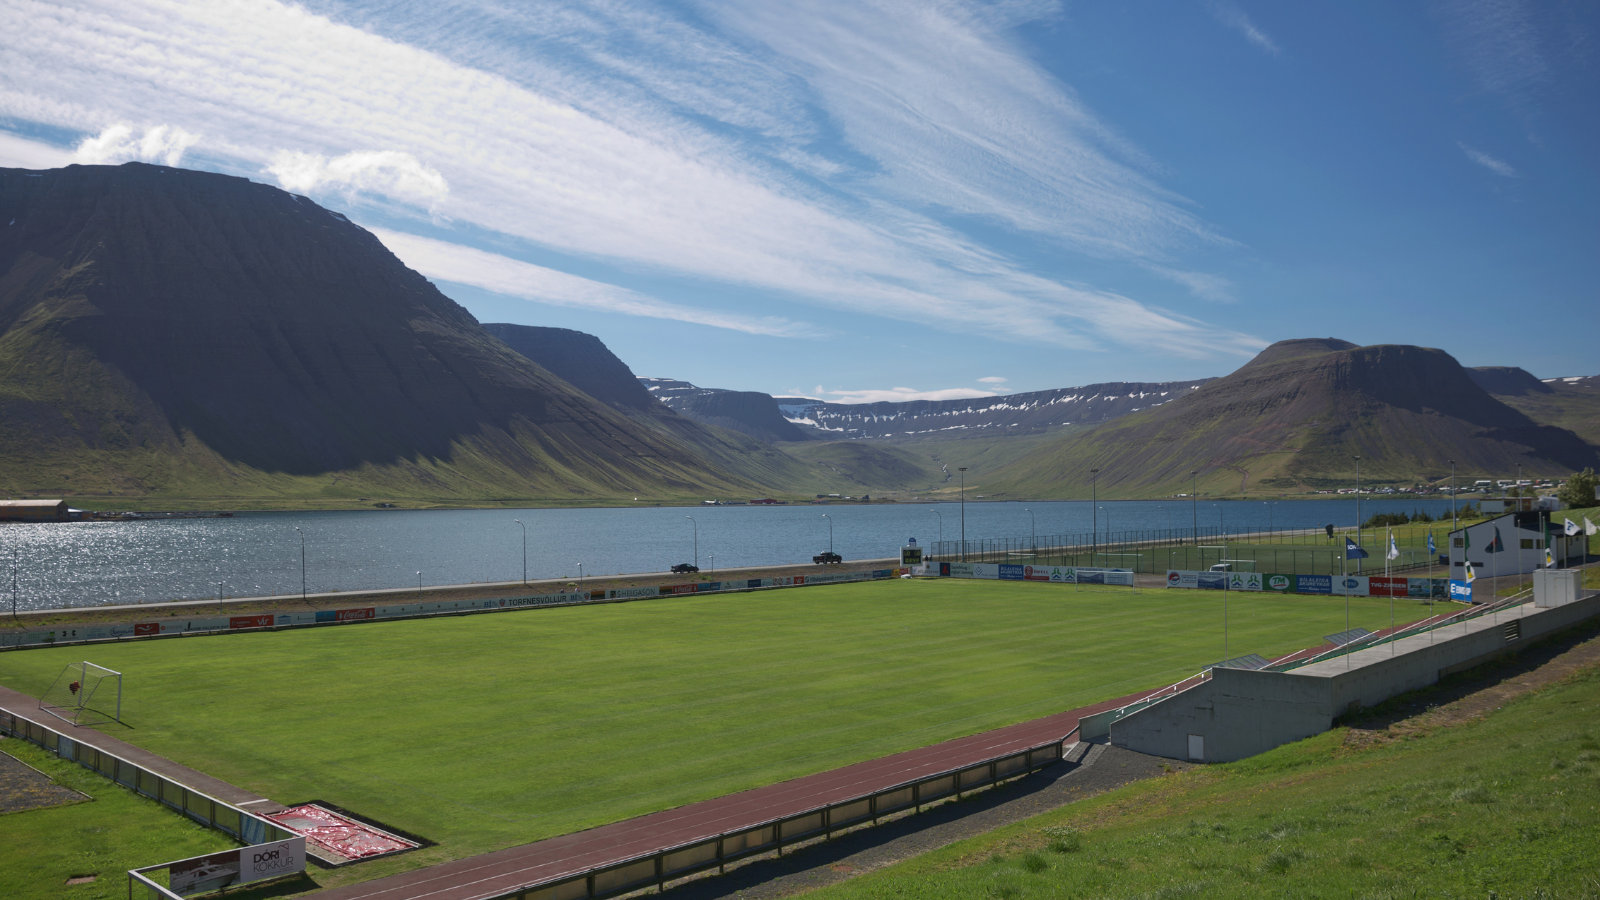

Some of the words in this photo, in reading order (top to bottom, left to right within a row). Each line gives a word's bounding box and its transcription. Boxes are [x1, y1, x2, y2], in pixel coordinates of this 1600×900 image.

[508, 596, 566, 606] TORFNESVÖLLUR
[344, 610, 366, 619] Coca-Cola
[254, 849, 279, 863] DÓRI
[254, 856, 294, 873] KOKKUR
